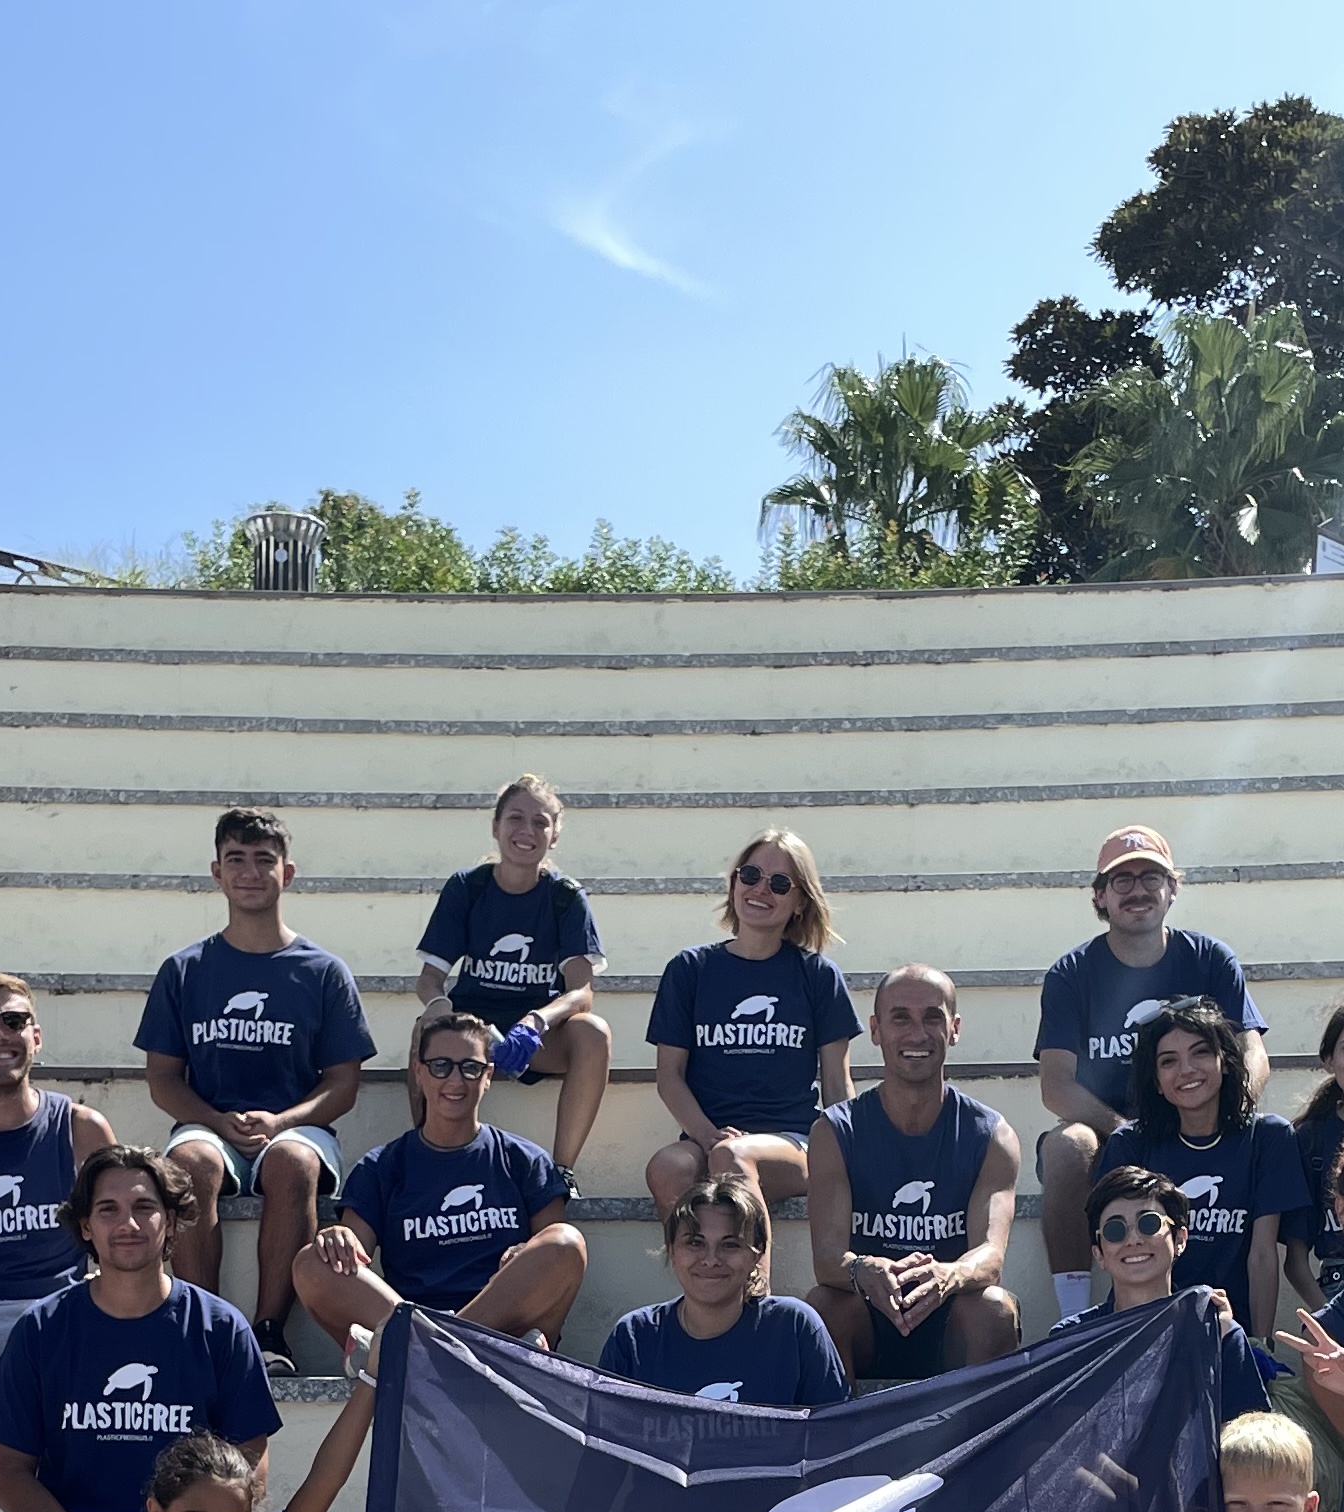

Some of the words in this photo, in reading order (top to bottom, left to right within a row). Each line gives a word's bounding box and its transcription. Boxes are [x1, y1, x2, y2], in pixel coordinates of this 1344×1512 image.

[192, 1018, 295, 1046] PLASTICFREE
[696, 1022, 807, 1049] PLASTICFREE
[403, 1207, 520, 1241] PLASTICFREE
[852, 1210, 966, 1241] PLASTICFREE
[61, 1401, 194, 1433] PLASTICFREE
